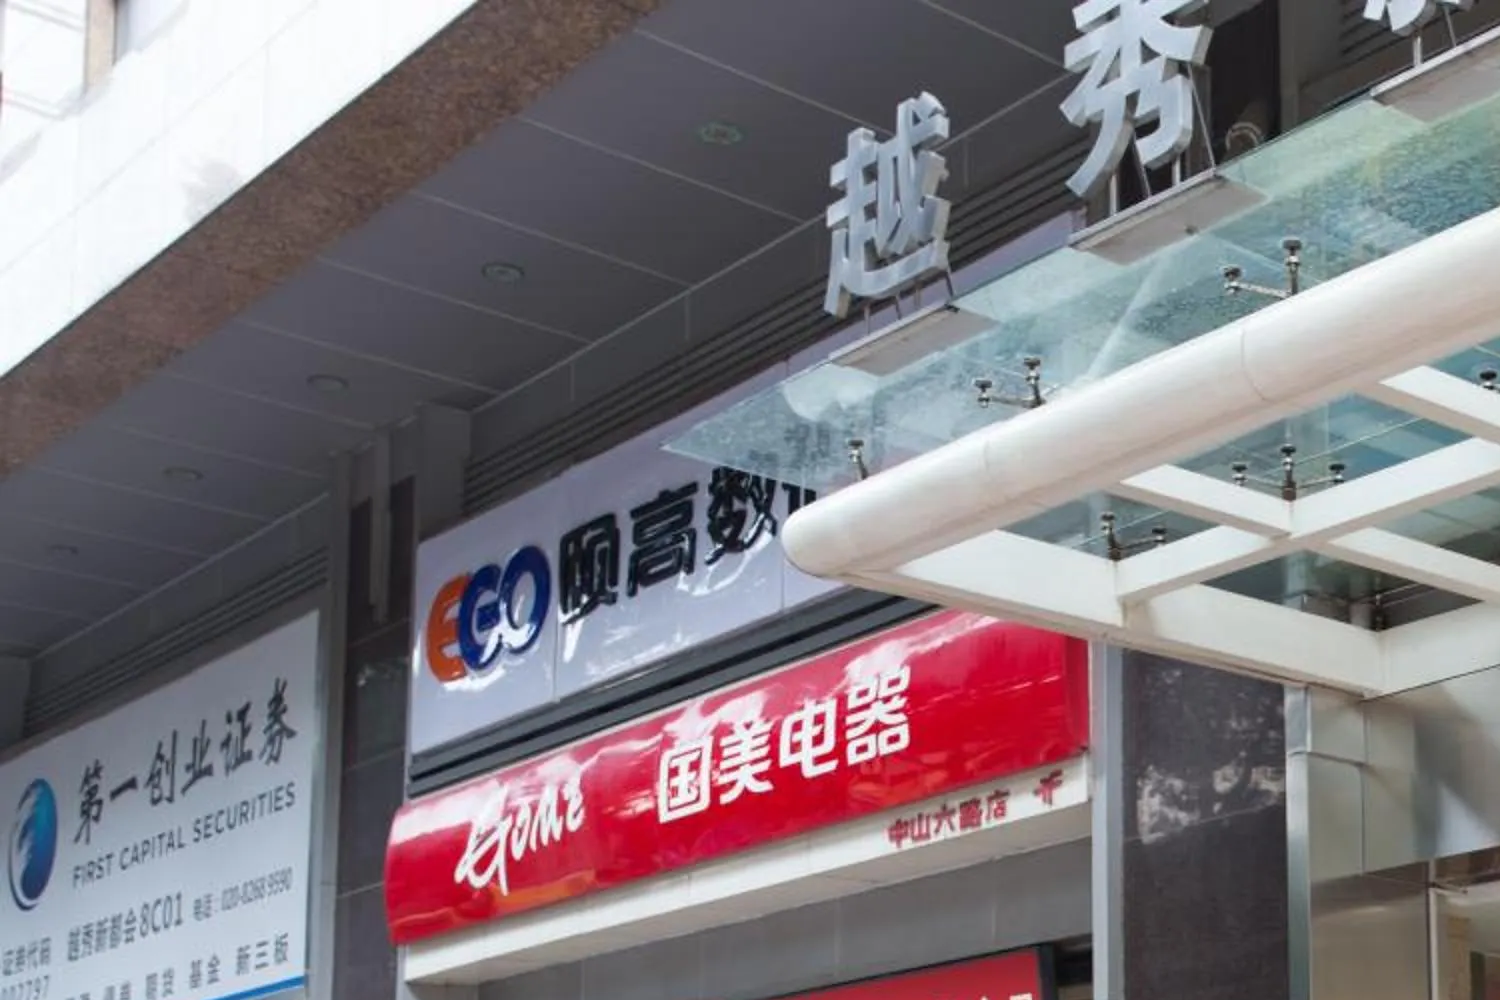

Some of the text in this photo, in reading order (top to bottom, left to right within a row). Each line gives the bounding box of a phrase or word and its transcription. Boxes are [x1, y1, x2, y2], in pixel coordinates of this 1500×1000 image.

[425, 545, 551, 683] EGO
[559, 464, 817, 625] 颐高数
[73, 677, 296, 845] 第一创业证券
[659, 665, 911, 824] 国美电器
[887, 789, 1010, 848] 中山六路店
[73, 781, 296, 890] FIRST CAPITAL SECURITIES
